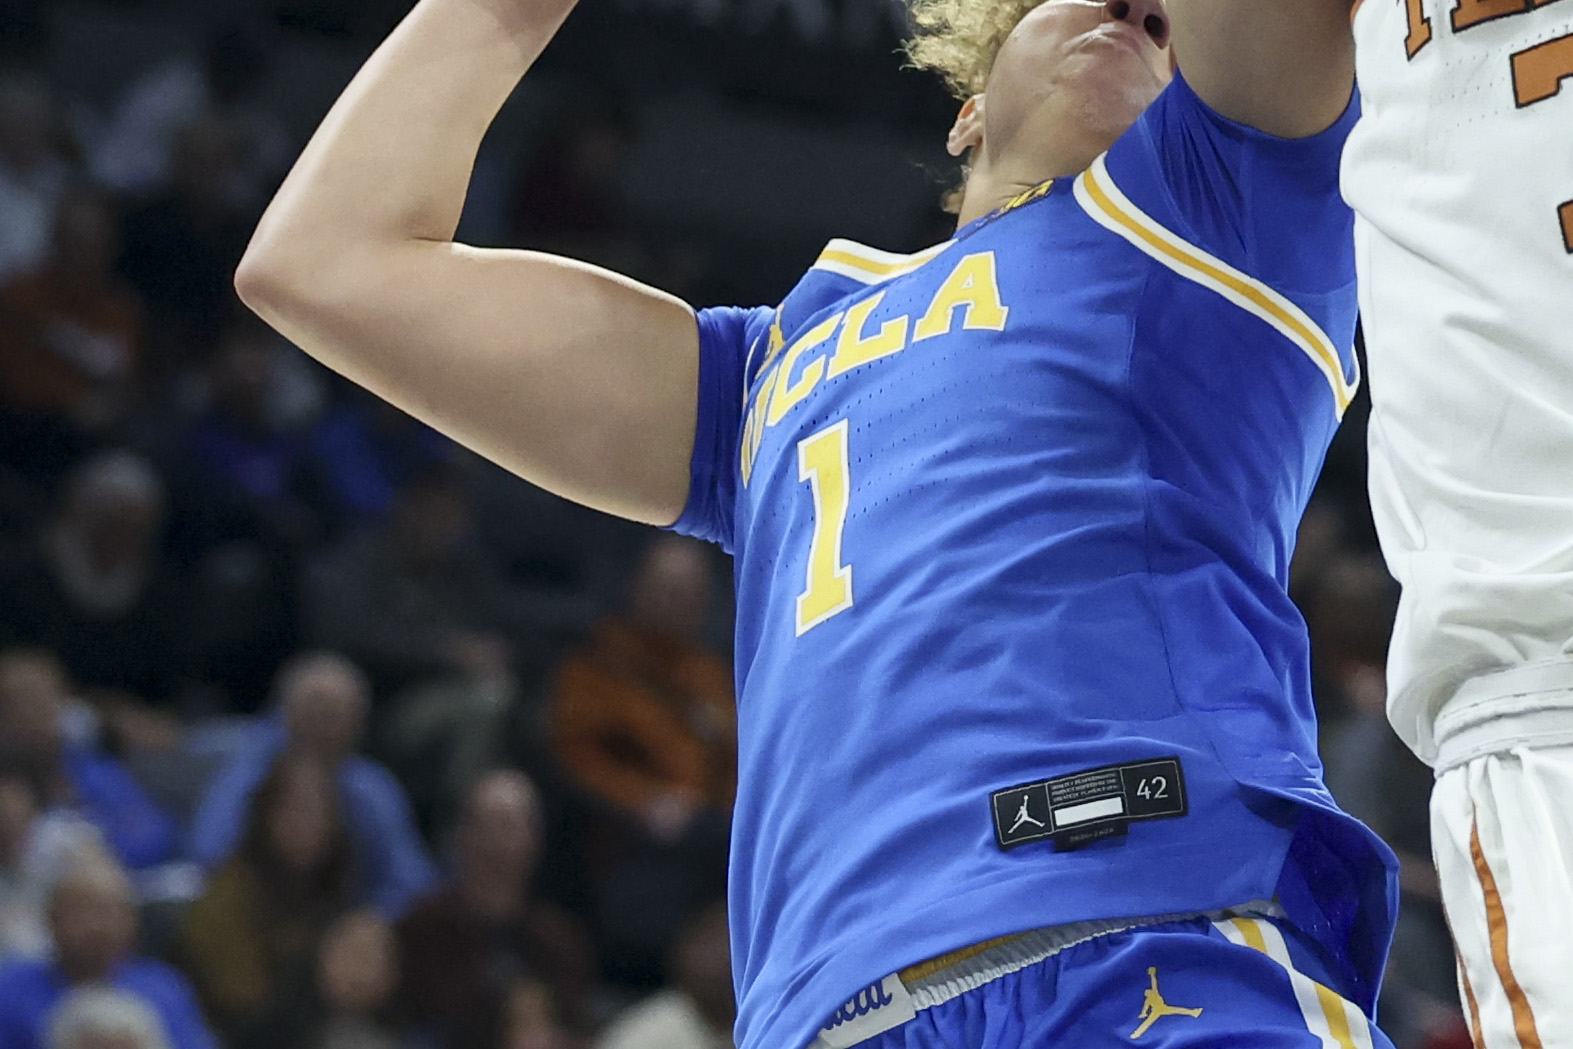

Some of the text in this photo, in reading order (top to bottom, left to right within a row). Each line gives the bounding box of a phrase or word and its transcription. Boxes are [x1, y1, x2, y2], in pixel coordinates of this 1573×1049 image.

[741, 250, 1009, 490] UCLA
[795, 417, 853, 638] 1
[1136, 775, 1169, 800] 42
